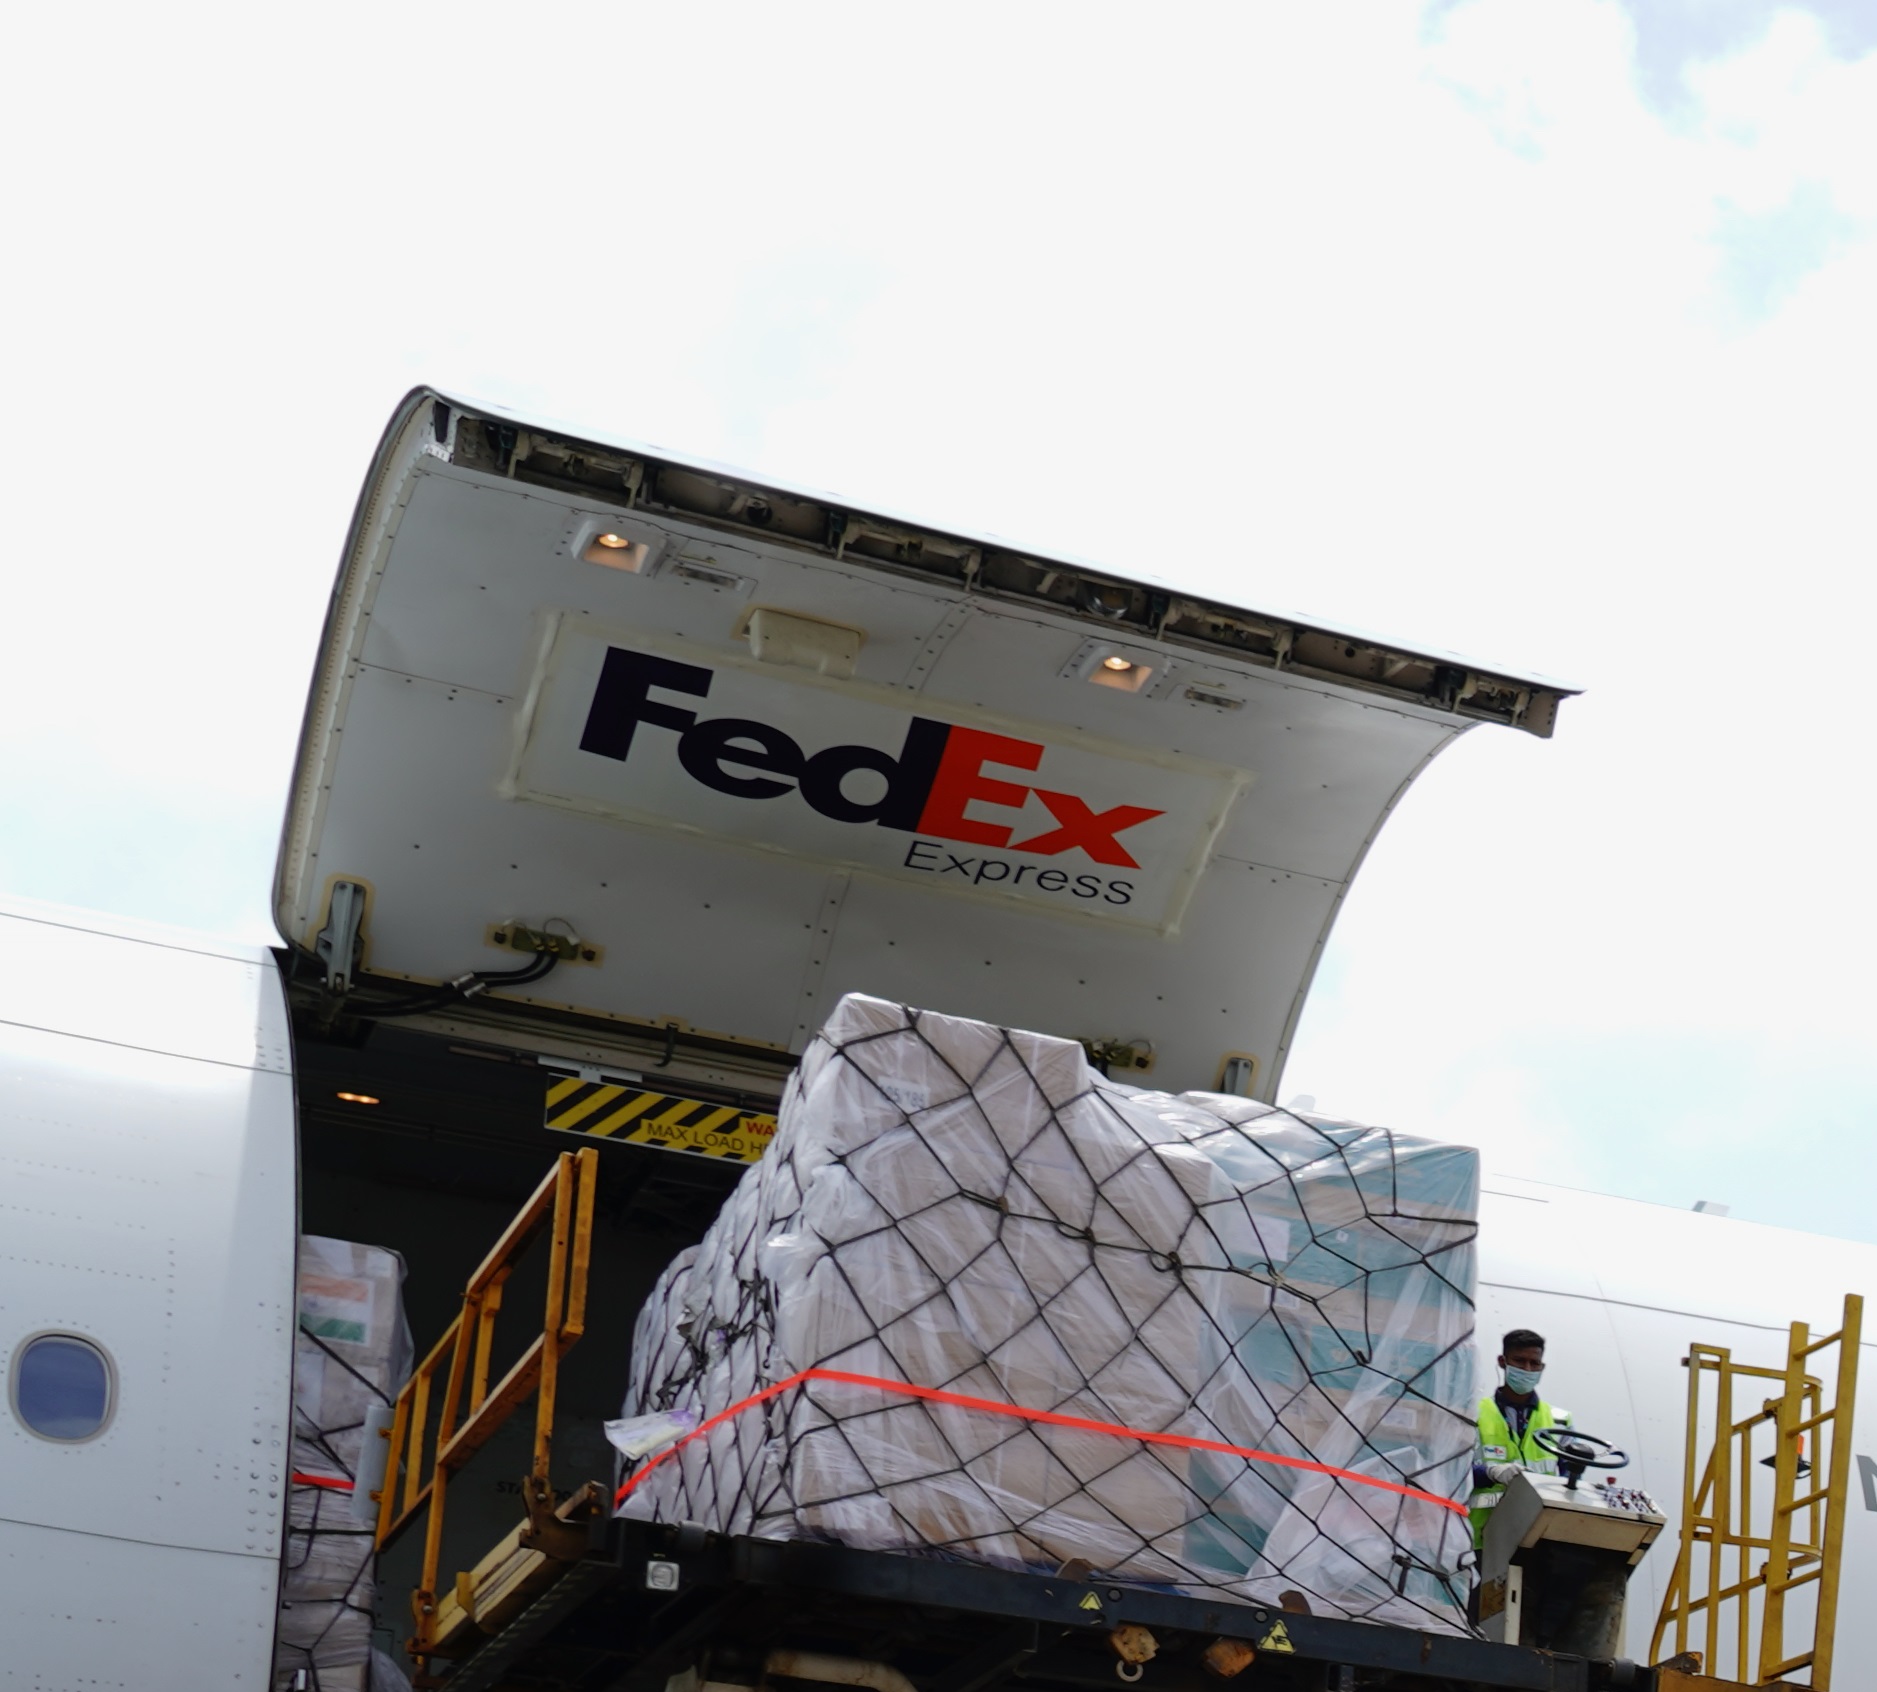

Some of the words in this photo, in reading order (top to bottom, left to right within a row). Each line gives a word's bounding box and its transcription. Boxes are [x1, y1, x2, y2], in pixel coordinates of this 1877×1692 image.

[578, 646, 1167, 870] FedEx
[903, 840, 1135, 906] Express
[646, 1122, 688, 1142] MAX
[693, 1131, 745, 1151] LOAD
